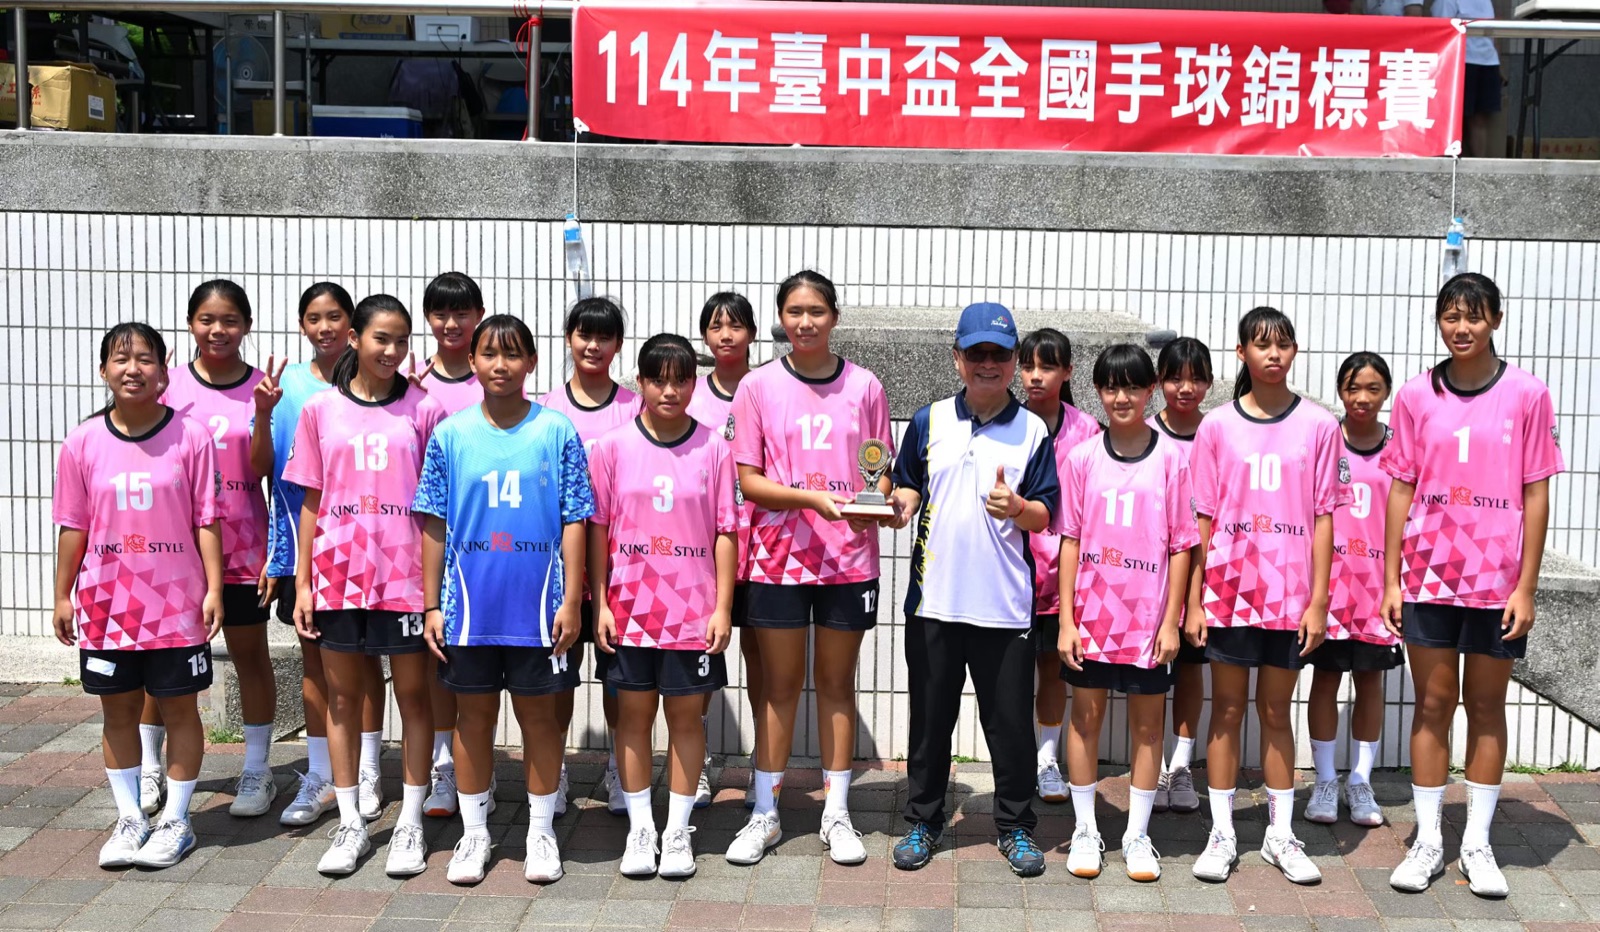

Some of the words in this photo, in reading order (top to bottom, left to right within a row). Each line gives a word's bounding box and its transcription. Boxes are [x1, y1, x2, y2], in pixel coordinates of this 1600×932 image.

[598, 29, 1439, 131] 114年臺中盃全國手球錦標賽
[208, 415, 229, 449] 2
[795, 413, 833, 450] 12
[1453, 426, 1471, 463] 1
[347, 432, 388, 471] 13
[1243, 452, 1282, 492] 10
[109, 472, 154, 511] 15
[226, 480, 257, 491] STYLE
[481, 470, 522, 508] 14
[652, 474, 674, 513] 3
[330, 504, 359, 518] KING
[1101, 488, 1135, 527] 11
[1349, 482, 1372, 519] 9
[1421, 494, 1448, 507] KING
[1473, 496, 1509, 509] STYLE
[1224, 522, 1252, 536] KING
[1274, 523, 1304, 536] STYLE
[94, 543, 122, 557] KING
[148, 543, 184, 553] STYLE
[461, 541, 489, 554] KING
[514, 541, 551, 552] STYLE
[620, 543, 649, 557] KING
[674, 546, 707, 557] STYLE
[1079, 552, 1100, 565] ING
[1123, 558, 1158, 573] STYLE
[861, 589, 876, 613] 12
[397, 613, 424, 637] 13
[187, 651, 208, 677] 15
[697, 654, 710, 677] 3
